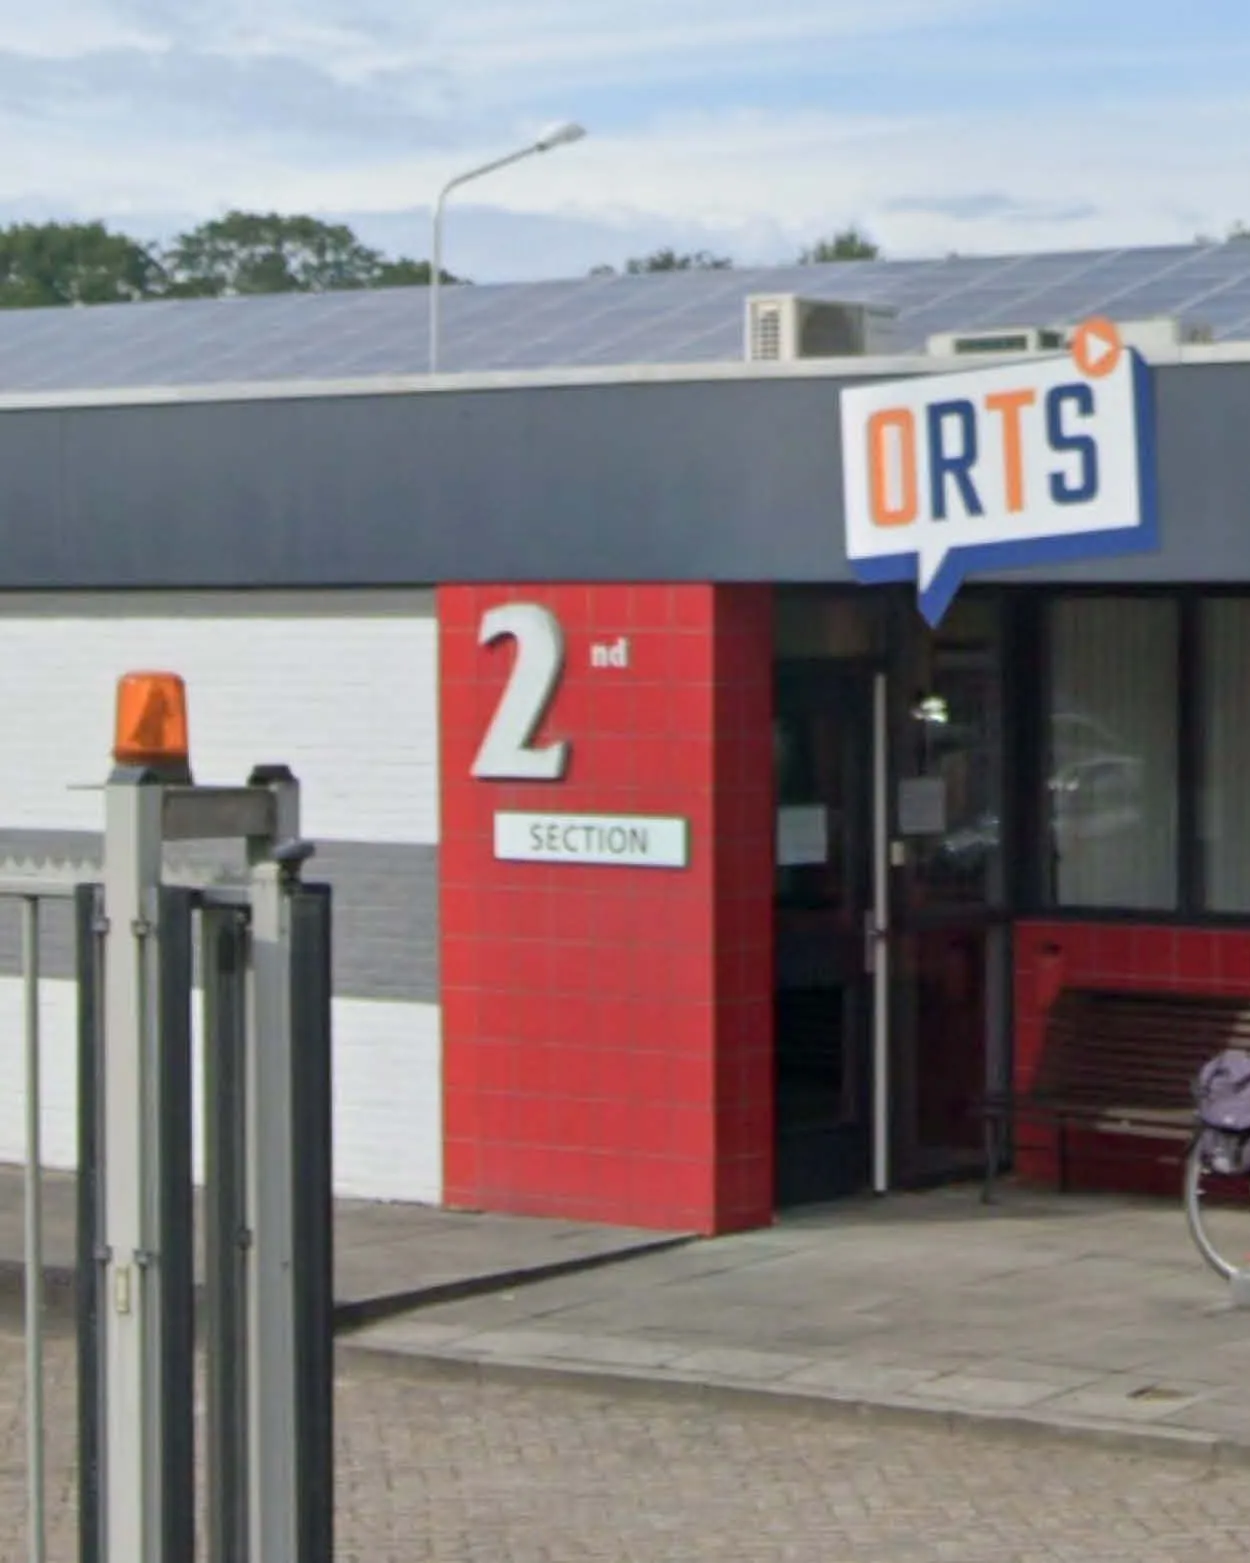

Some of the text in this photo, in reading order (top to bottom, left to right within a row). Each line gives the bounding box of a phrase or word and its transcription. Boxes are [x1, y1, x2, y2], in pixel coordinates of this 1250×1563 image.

[867, 381, 1098, 527] ORTS
[469, 602, 629, 780] 2 nd
[529, 823, 649, 855] SECTION
